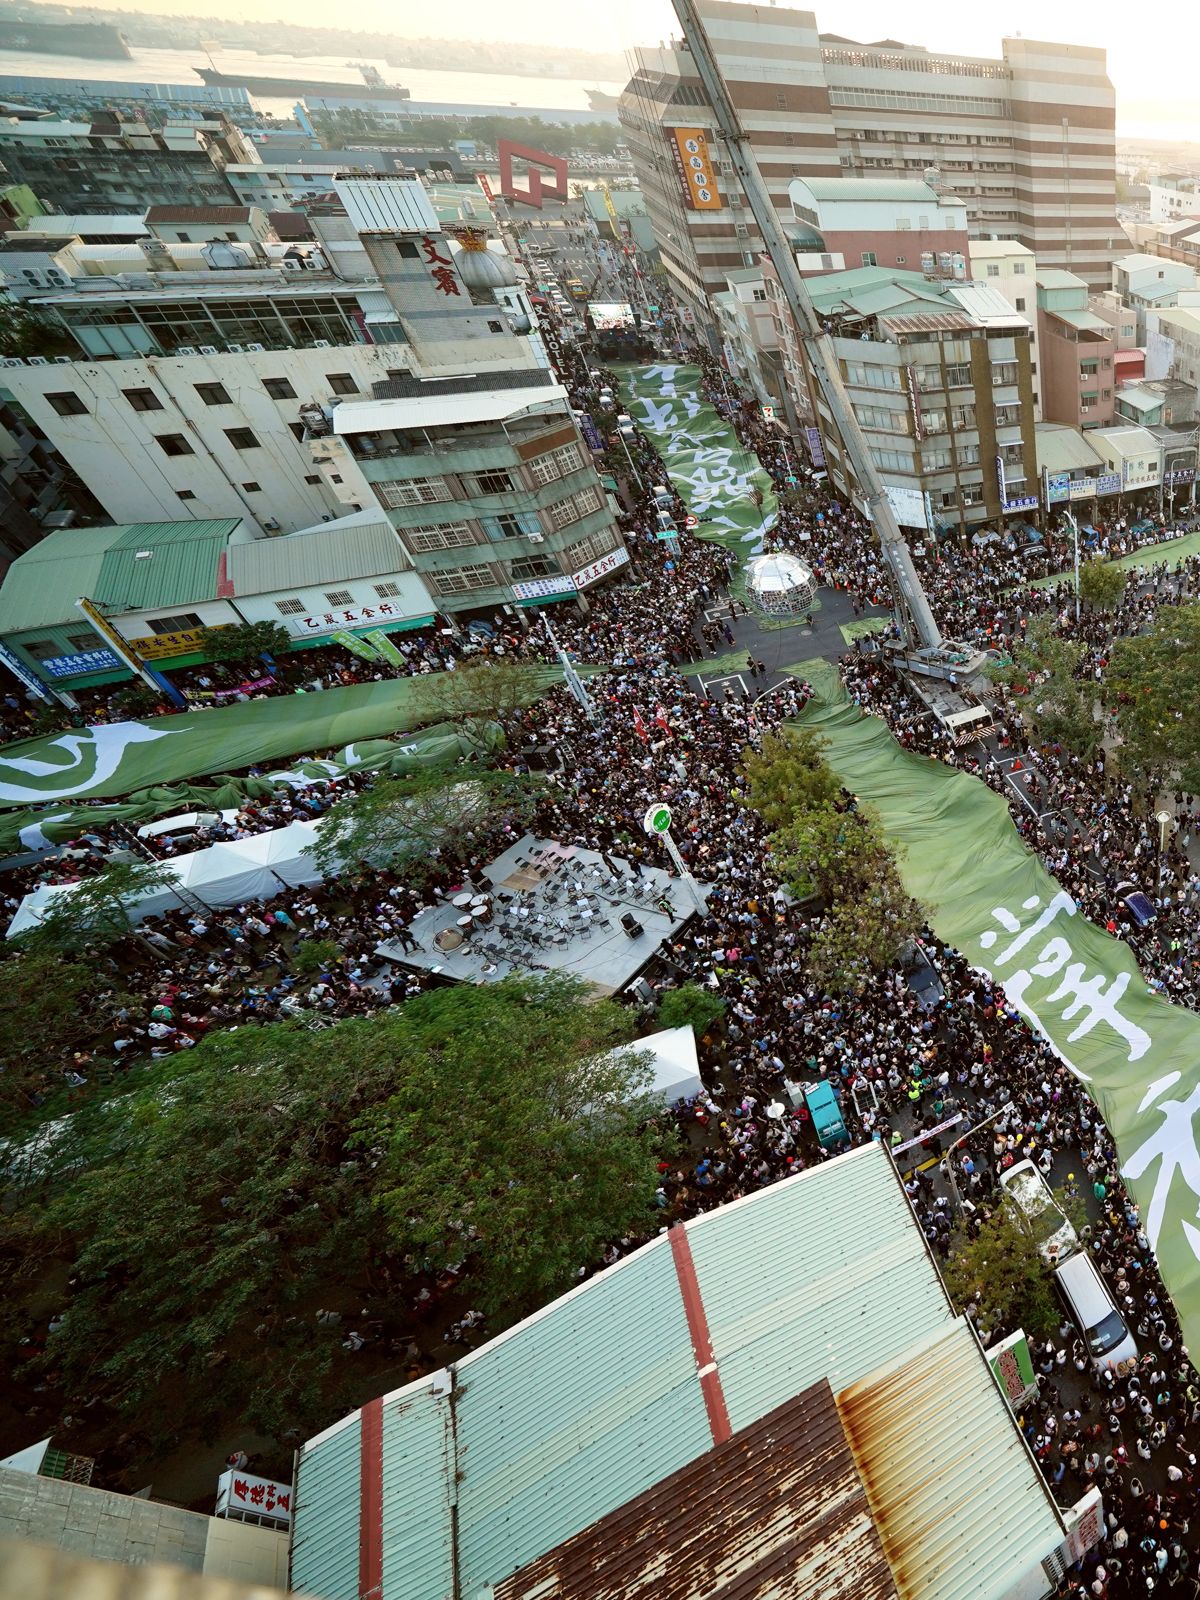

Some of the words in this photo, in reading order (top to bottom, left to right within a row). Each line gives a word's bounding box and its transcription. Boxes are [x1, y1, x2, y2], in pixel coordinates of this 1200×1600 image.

[421, 235, 461, 296] 文賓
[534, 304, 551, 331] 文賓
[545, 332, 569, 375] HOTEL
